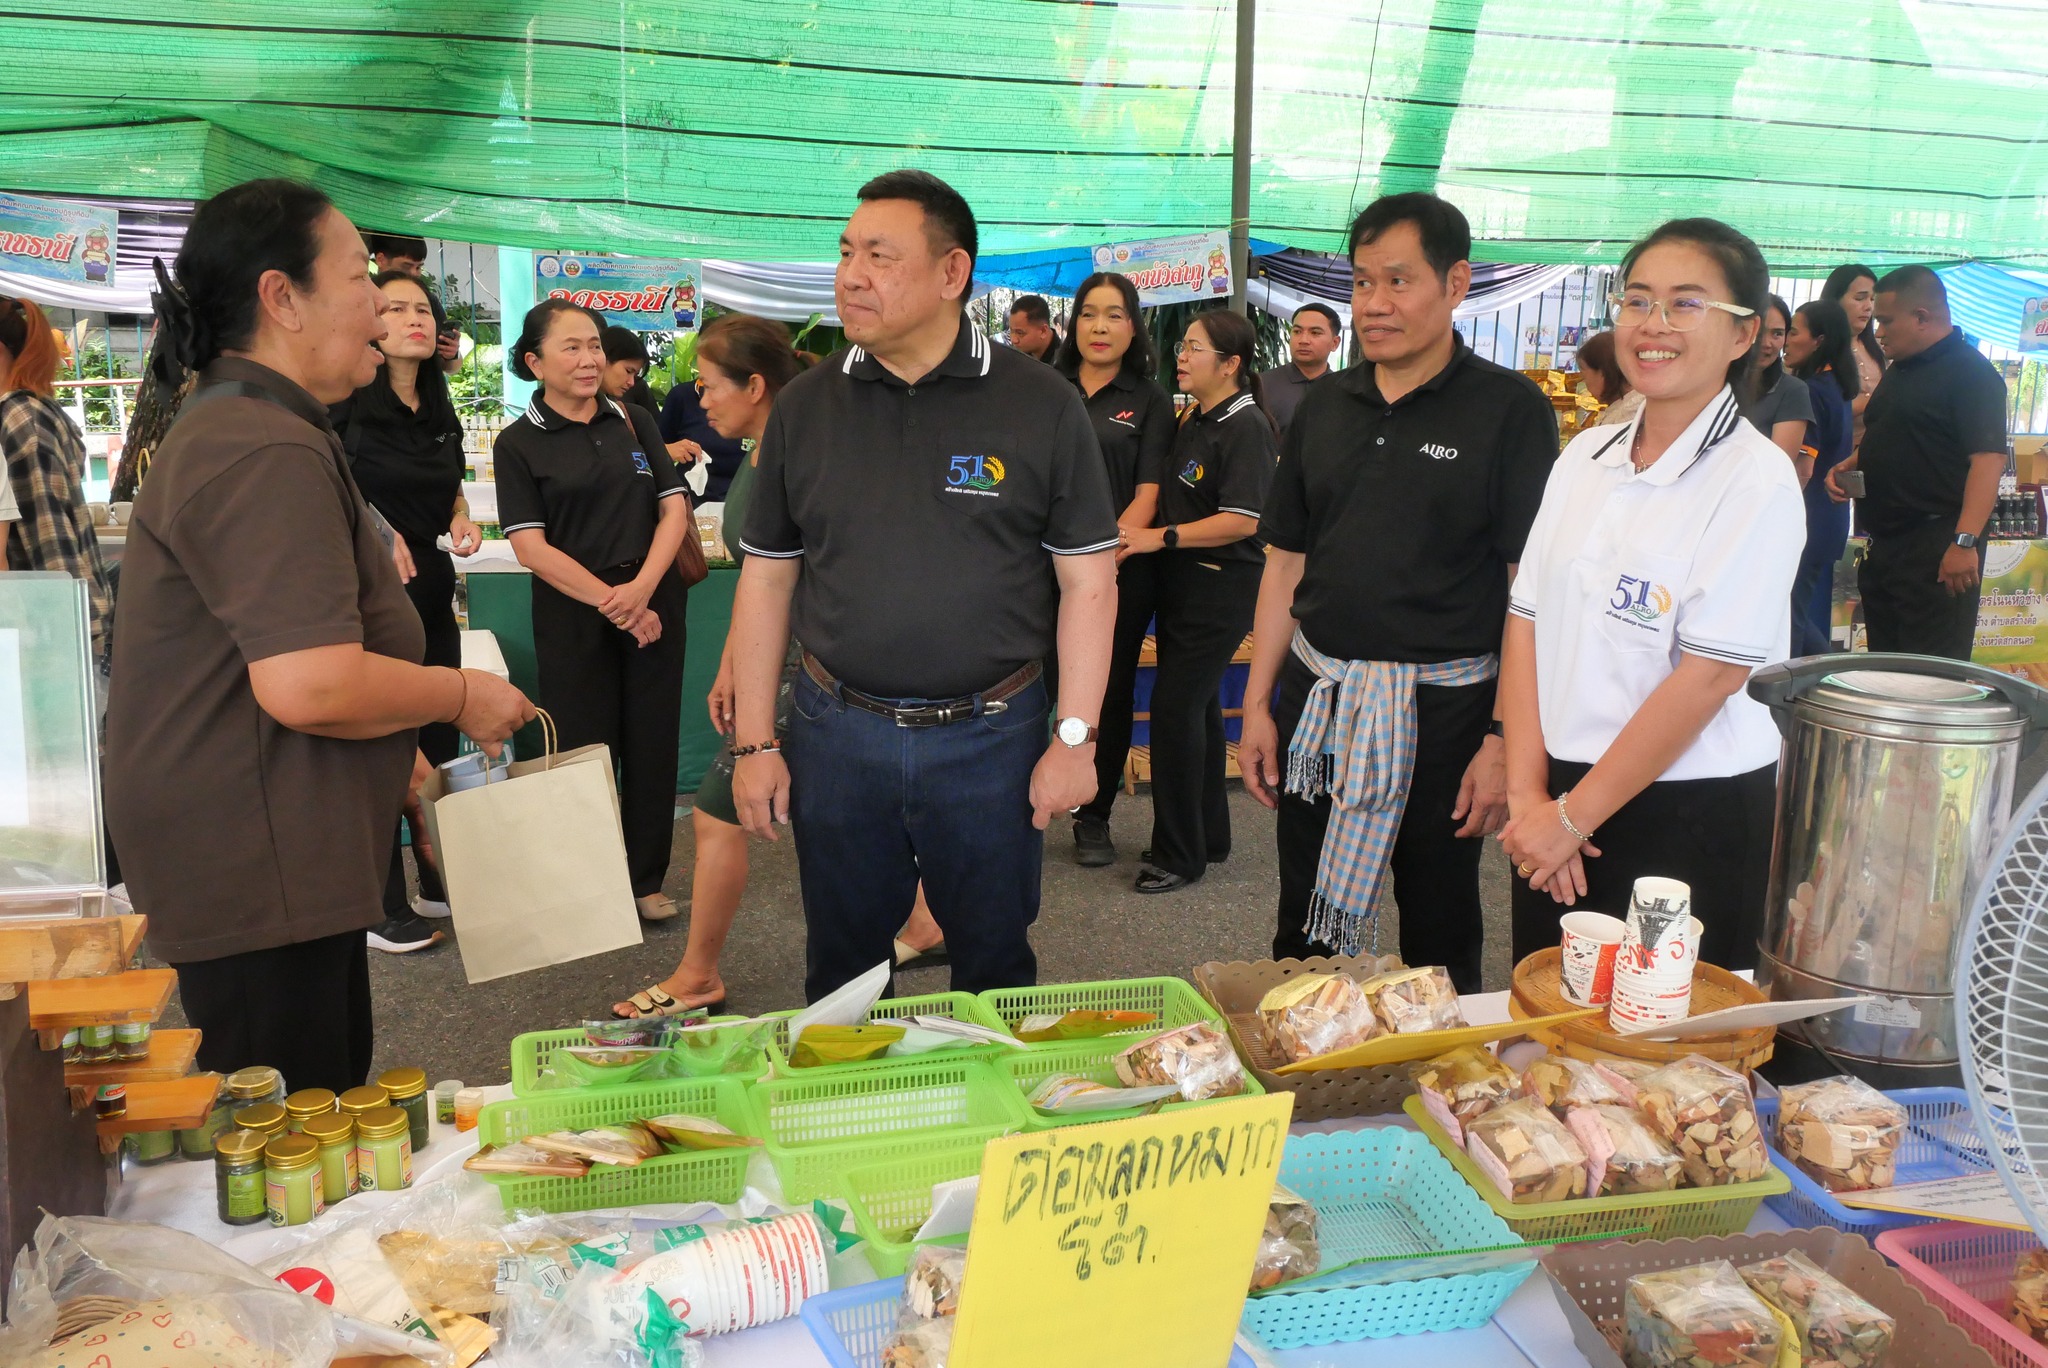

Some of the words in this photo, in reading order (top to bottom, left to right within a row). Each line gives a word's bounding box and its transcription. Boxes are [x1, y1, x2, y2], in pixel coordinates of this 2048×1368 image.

[0, 232, 76, 261] าชธานี
[1419, 443, 1458, 460] ALRO
[946, 455, 986, 485] 51
[1610, 574, 1651, 610] 51
[1630, 604, 1652, 615] ALRO
[1980, 635, 2034, 647] จังหวัดสกลนคร
